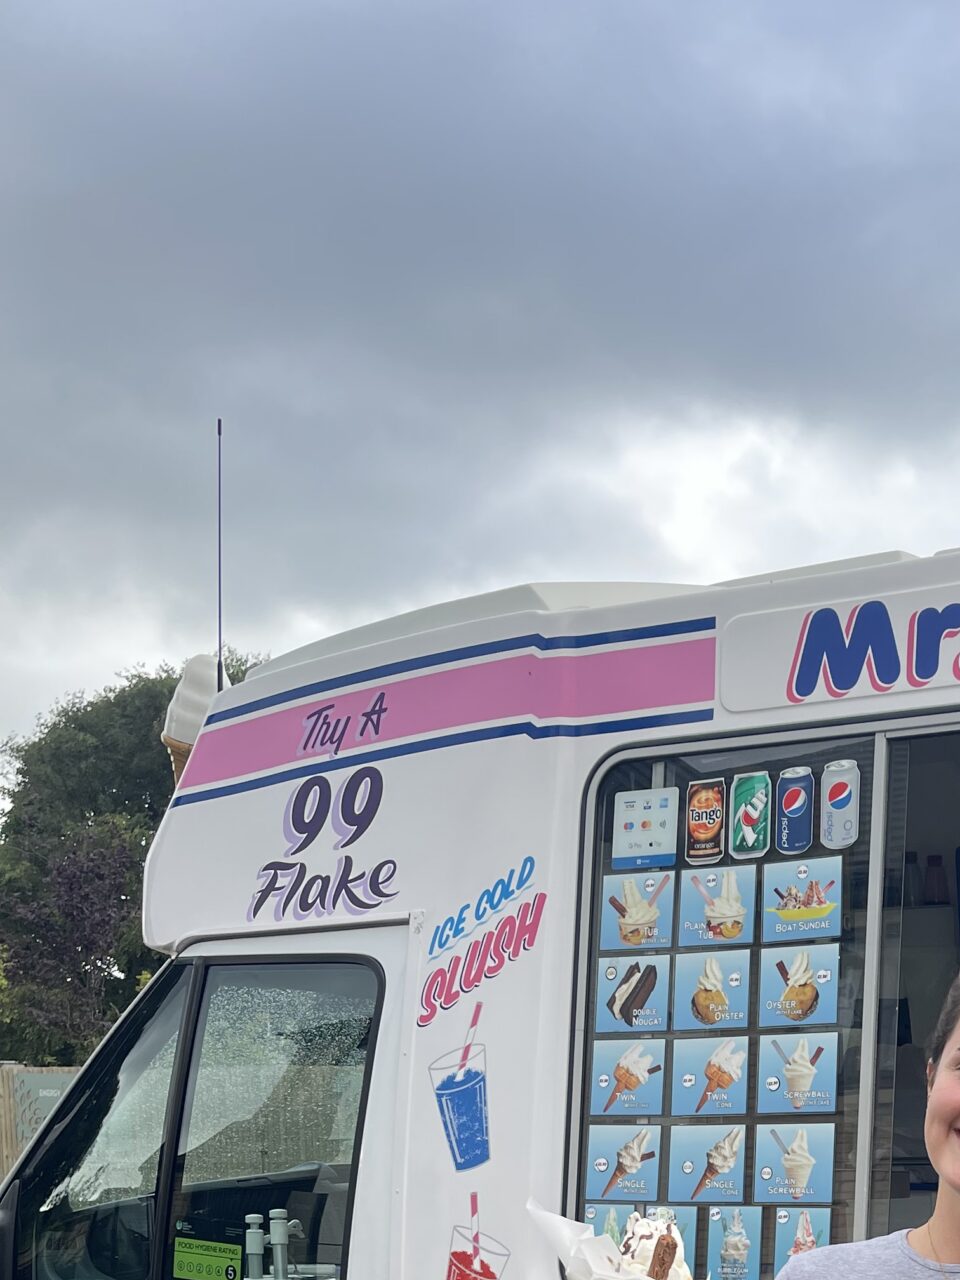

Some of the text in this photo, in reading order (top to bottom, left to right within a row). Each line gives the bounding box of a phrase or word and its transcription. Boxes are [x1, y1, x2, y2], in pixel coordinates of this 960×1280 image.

[297, 692, 388, 758] Try A
[283, 766, 384, 857] 99
[689, 804, 722, 826] Tango
[781, 817, 790, 848] pepsi
[246, 855, 400, 923] Flake
[428, 855, 536, 956] ICE COLD
[684, 921, 706, 930] PLAIN
[775, 920, 831, 933] BOAT SUNDAE
[644, 927, 659, 936] TUB
[698, 930, 714, 939] TUB
[416, 892, 548, 1028] SLUSH
[709, 1003, 729, 1012] PLAIN
[766, 1000, 797, 1010] OYSTER
[632, 1008, 657, 1016] DOUBLE
[714, 1012, 744, 1021] OYSTER
[632, 1017, 662, 1026] NOUGAT
[615, 1092, 636, 1101] TWIN
[706, 1092, 728, 1101] TWIN
[783, 1090, 830, 1099] SCREWBALL
[617, 1178, 646, 1188] SINGLE
[705, 1178, 734, 1189] SINGLE
[776, 1176, 796, 1185] PLAIN
[721, 1188, 738, 1196] CONE
[768, 1186, 815, 1195] SCREWBALL
[177, 1241, 238, 1256] FOOD HYGIENE RATING
[227, 1266, 235, 1280] 5
